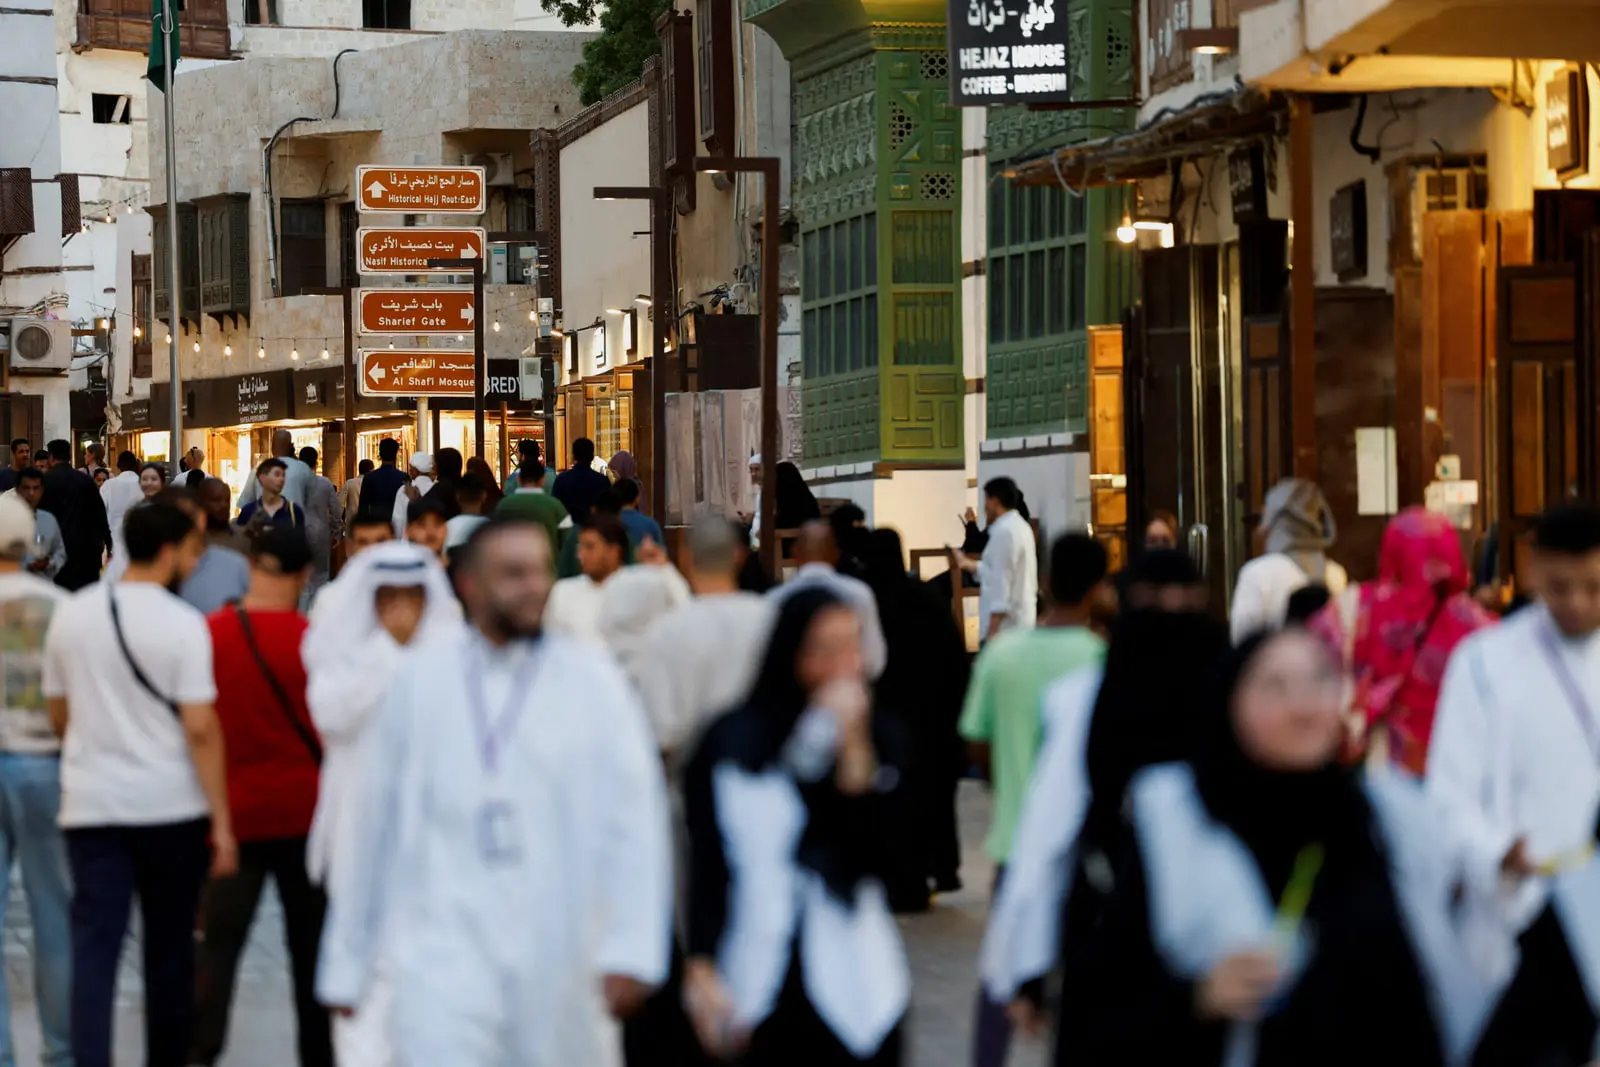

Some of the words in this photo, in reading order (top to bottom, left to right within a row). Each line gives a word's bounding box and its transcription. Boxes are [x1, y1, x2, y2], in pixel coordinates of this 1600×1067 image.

[959, 46, 1010, 70] HEJAZ
[1011, 43, 1066, 68] HOUSE
[961, 75, 1007, 95] COFFEE
[409, 175, 438, 190] التاريخي
[439, 175, 456, 189] الحج
[457, 175, 475, 188] مسار
[388, 194, 422, 204] Historical
[424, 194, 439, 205] Hajj
[368, 235, 398, 254] الأثري
[400, 239, 433, 252] نصيف
[434, 241, 454, 252] بيت
[365, 257, 387, 266] Nasif
[390, 257, 430, 266] Historica
[381, 298, 418, 312] شريف
[421, 298, 443, 312] باب
[378, 316, 416, 326] Sharief
[421, 316, 447, 326] Gate
[391, 357, 436, 374] الشافعي
[439, 361, 475, 372] مسجد
[392, 377, 404, 386] Al
[439, 377, 475, 387] Mosque
